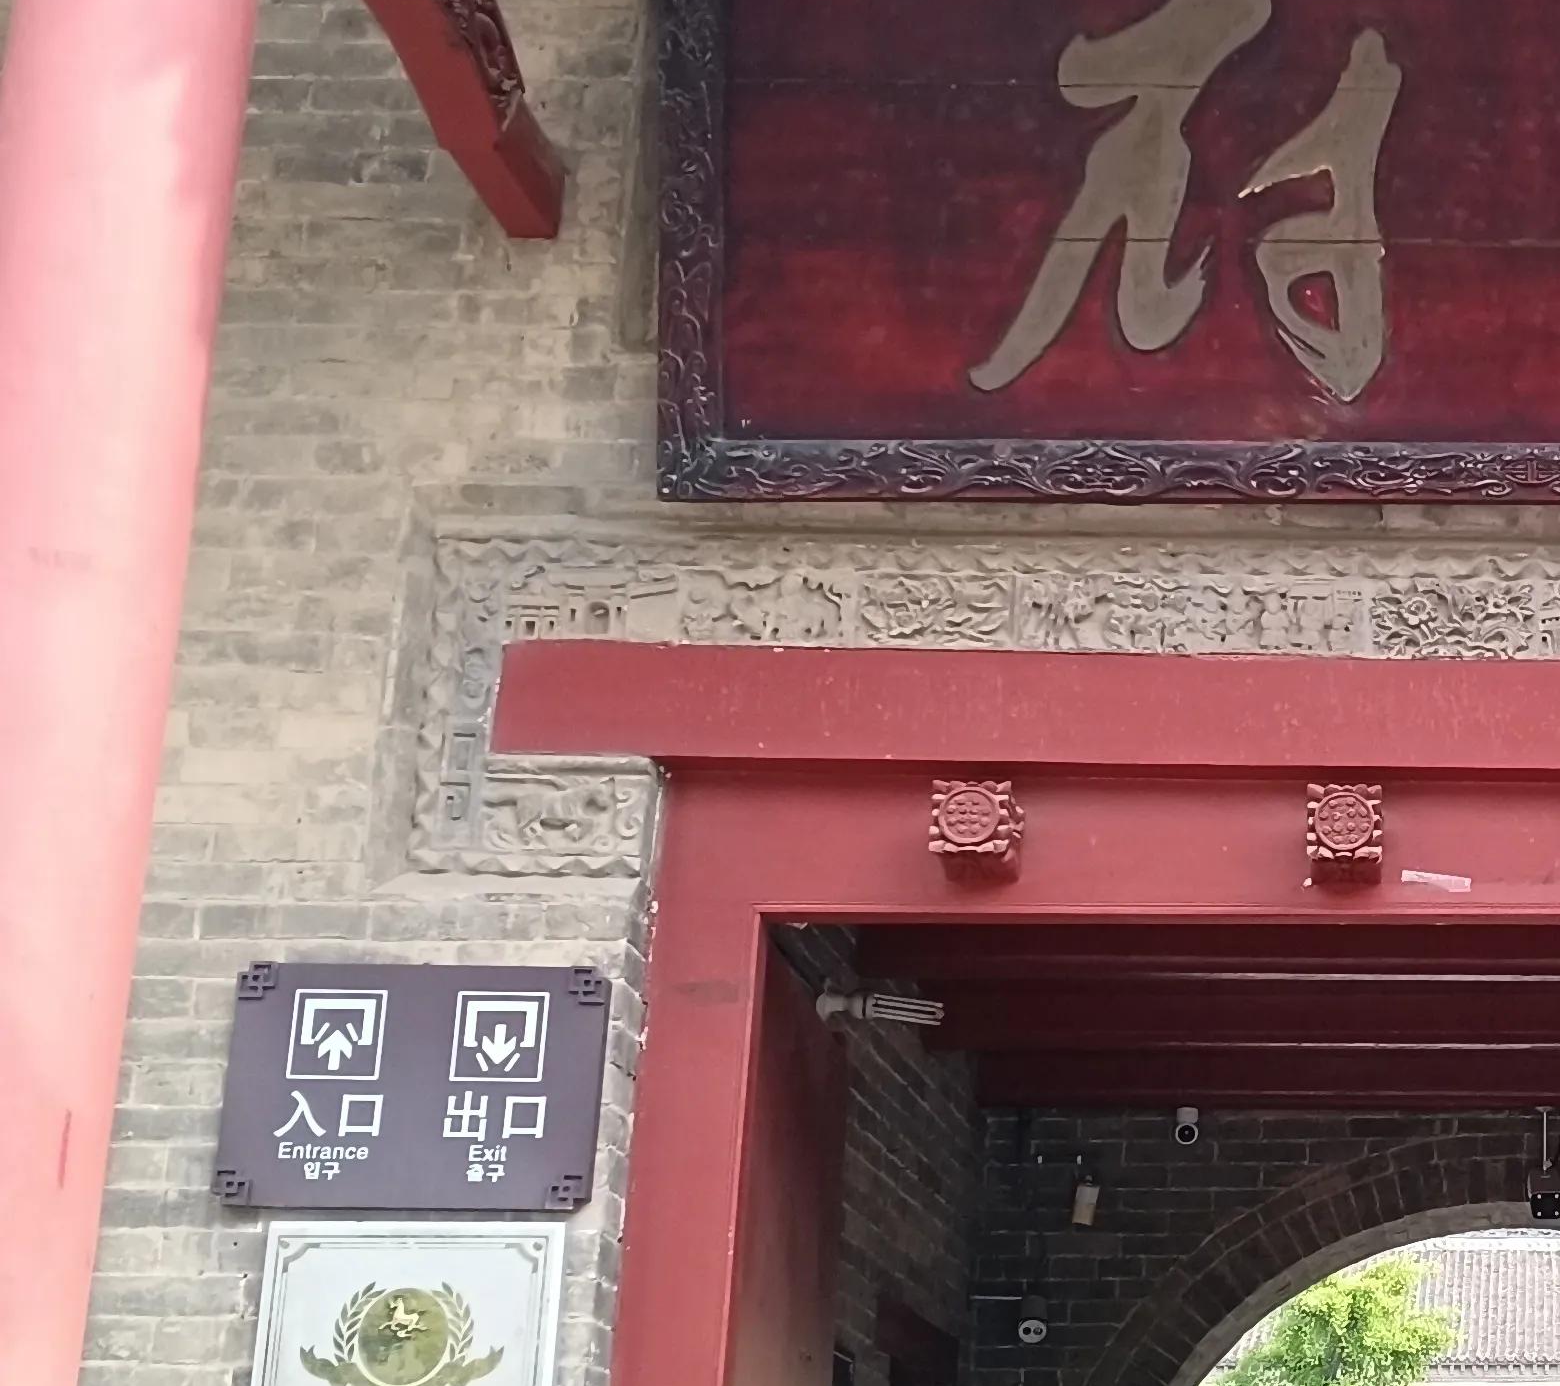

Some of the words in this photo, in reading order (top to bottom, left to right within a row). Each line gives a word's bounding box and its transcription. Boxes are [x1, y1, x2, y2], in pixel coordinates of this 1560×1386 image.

[273, 1090, 384, 1137] 入口
[443, 1091, 547, 1141] 出口
[278, 1141, 369, 1160] Entrance
[468, 1144, 507, 1162] Exit
